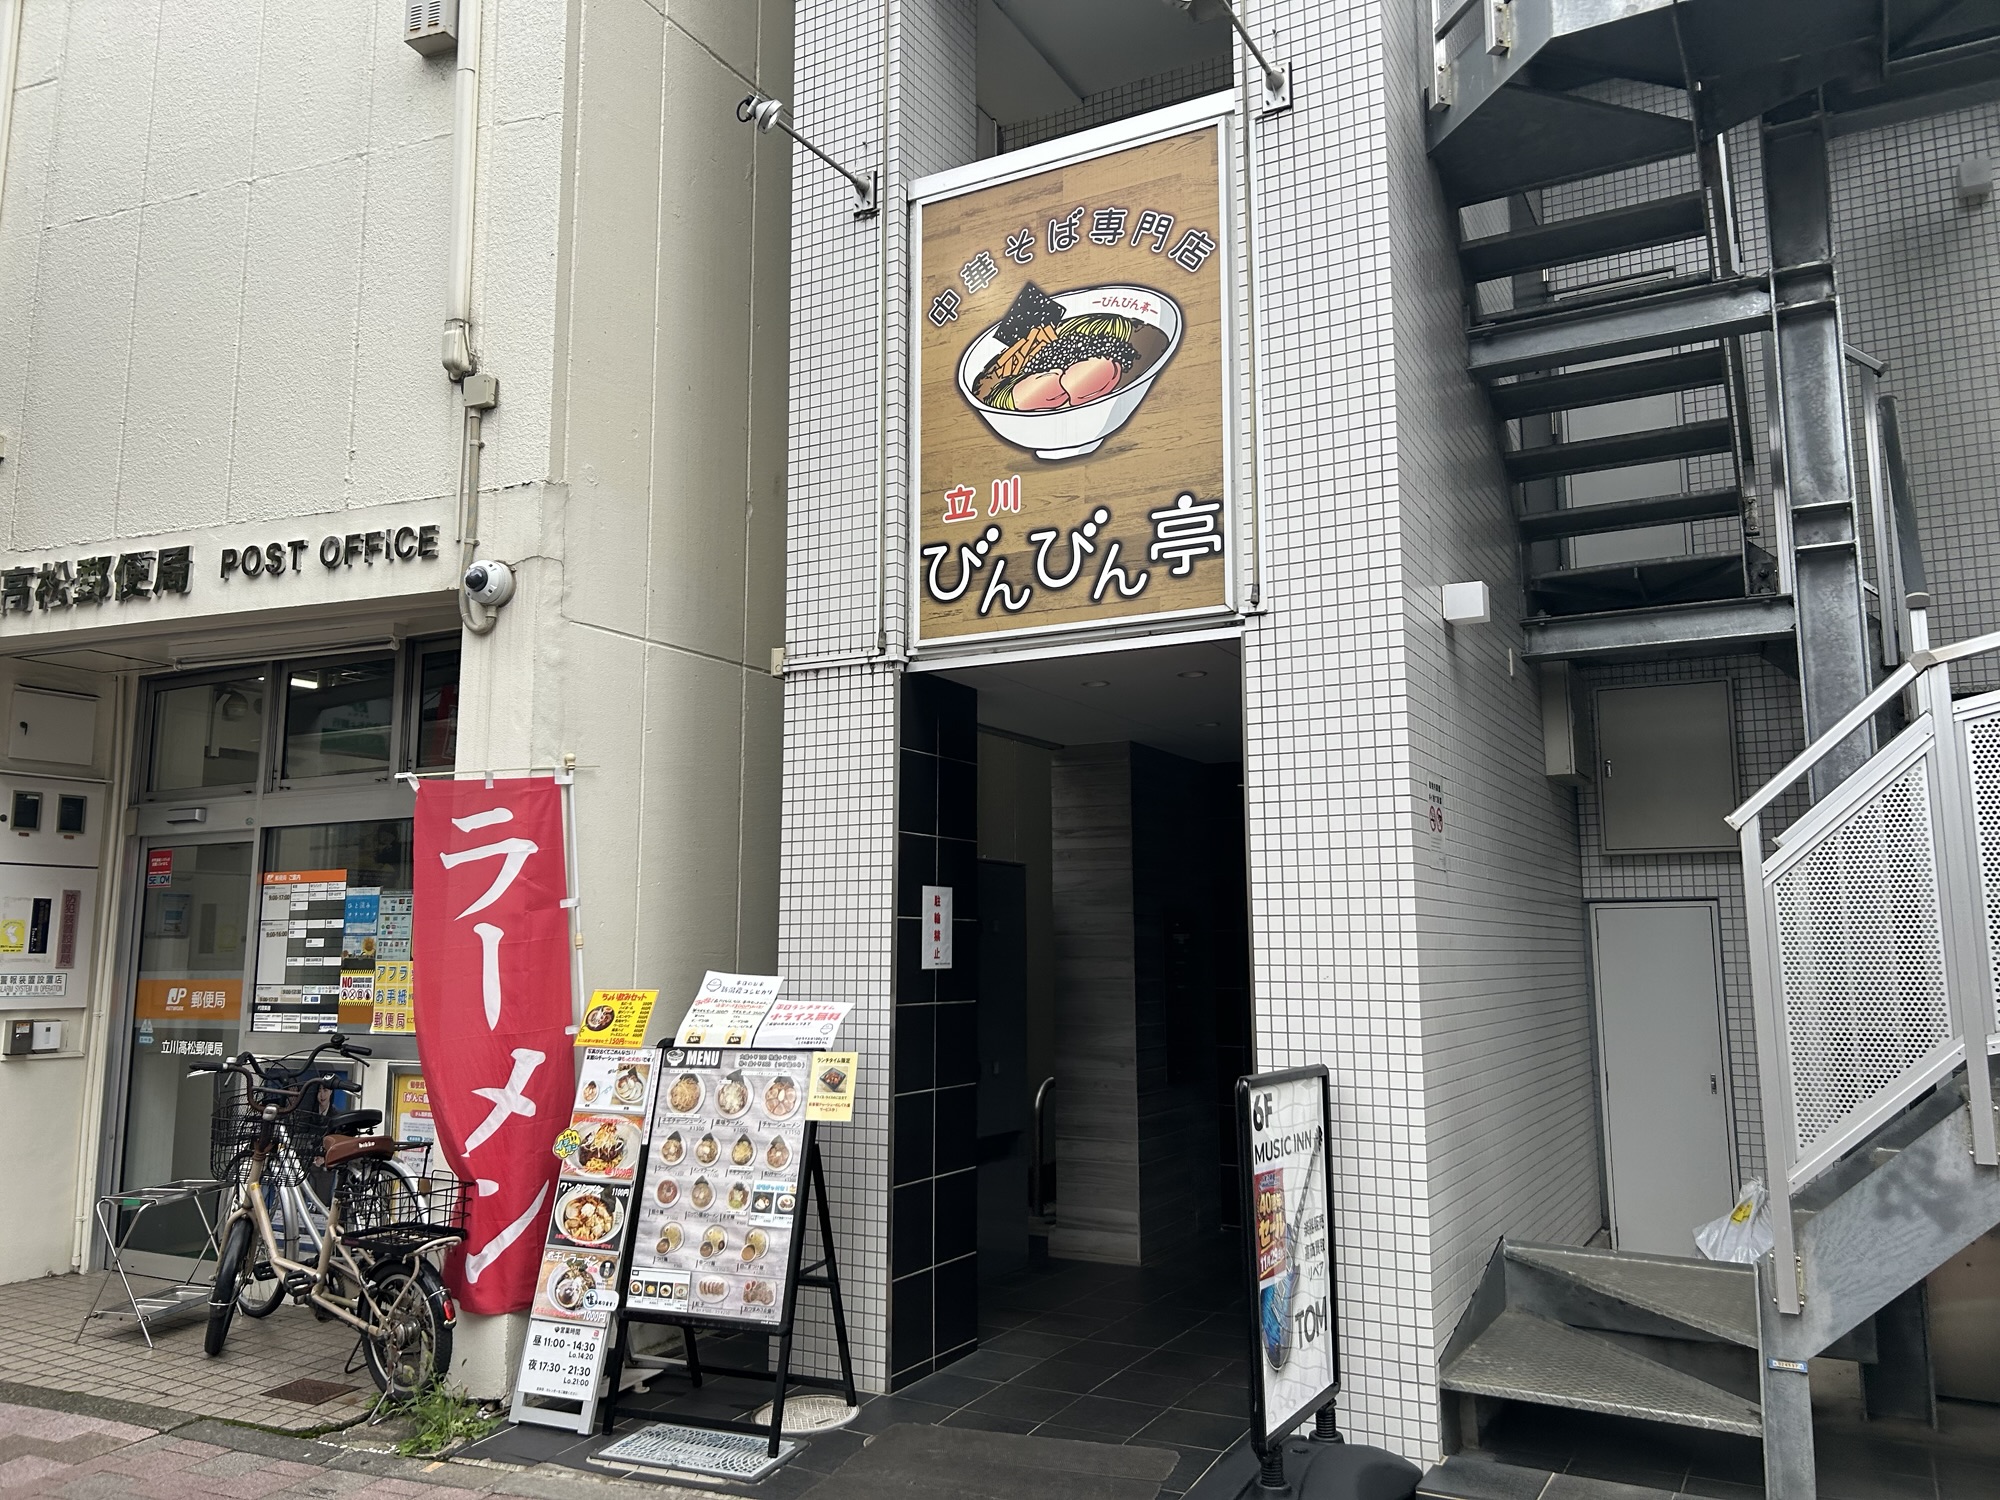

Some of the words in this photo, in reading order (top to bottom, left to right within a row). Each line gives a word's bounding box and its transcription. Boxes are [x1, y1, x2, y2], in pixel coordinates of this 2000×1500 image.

[928, 206, 1216, 328] 中華そば専門店
[943, 474, 1022, 524] 立川
[220, 539, 309, 580] POST
[319, 524, 440, 569] OFFICE
[922, 493, 1223, 617] びんびん亭
[342, 976, 353, 988] NO
[376, 965, 412, 982] アフラ
[190, 991, 226, 1009] 郵便局
[373, 1012, 405, 1029] 郵便局
[770, 1012, 842, 1021] 小ライス無料
[160, 1039, 223, 1057] 立川高松郵便局
[439, 806, 550, 1284] ラーメン
[685, 1049, 720, 1066] MENU
[1253, 1092, 1273, 1132] 6F
[1254, 1135, 1292, 1165] MUSIC
[1293, 1129, 1312, 1153] INN
[1258, 1211, 1286, 1248] セール
[1307, 1261, 1324, 1282] リペア
[560, 1326, 581, 1335] 営業時間
[1294, 1295, 1328, 1350] TOM
[532, 1334, 542, 1346] 昼
[543, 1337, 565, 1349] 11:00
[572, 1341, 596, 1352] 14:30
[528, 1359, 538, 1371] 夜
[538, 1361, 561, 1373] 17:30
[567, 1365, 591, 1377] 21:30
